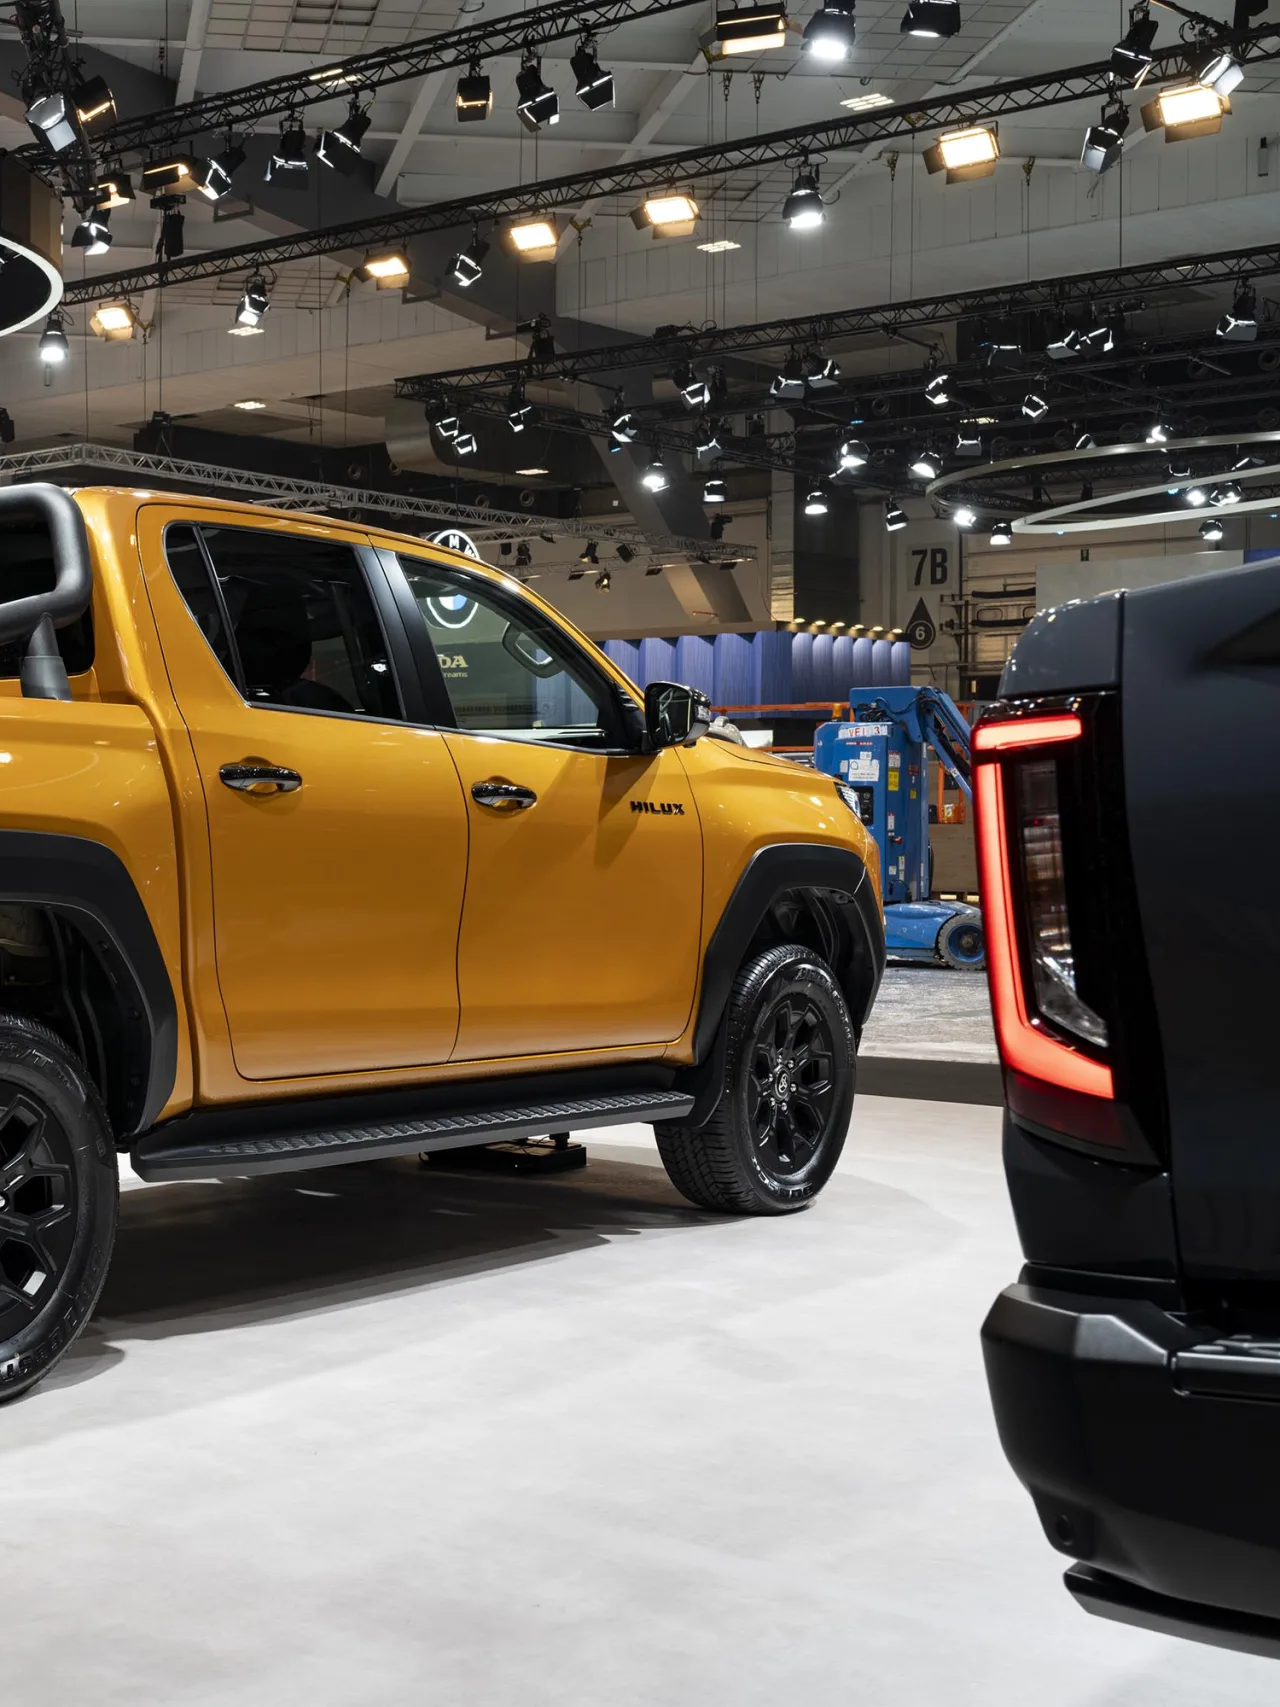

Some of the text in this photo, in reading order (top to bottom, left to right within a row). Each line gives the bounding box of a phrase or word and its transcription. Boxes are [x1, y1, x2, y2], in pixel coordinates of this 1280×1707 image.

[911, 548, 948, 586] 7B
[915, 626, 926, 640] 6
[630, 800, 686, 816] HILUX
